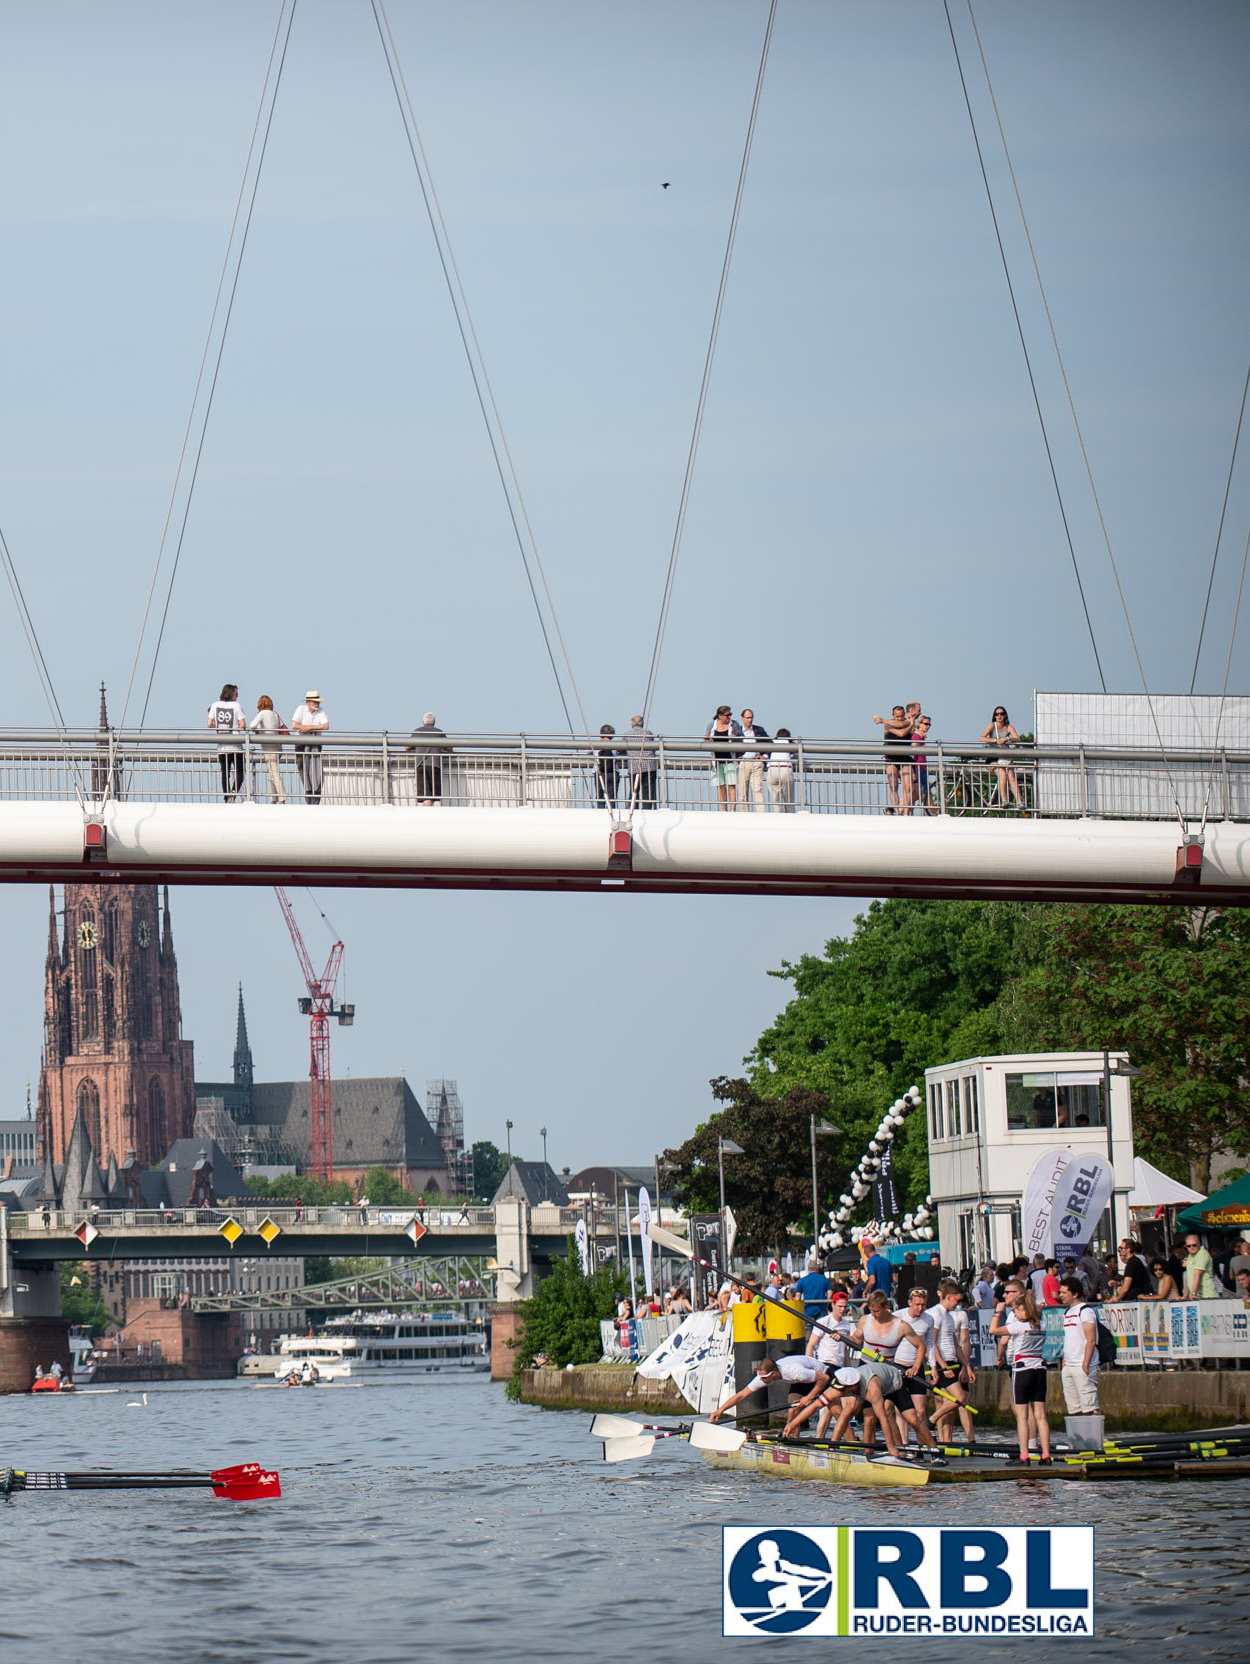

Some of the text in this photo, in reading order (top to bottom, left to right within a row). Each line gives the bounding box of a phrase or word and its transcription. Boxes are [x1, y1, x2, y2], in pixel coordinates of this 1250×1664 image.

[218, 711, 231, 723] 89
[1028, 1156, 1068, 1252] BEST AUDIT
[1066, 1165, 1099, 1214] RBL
